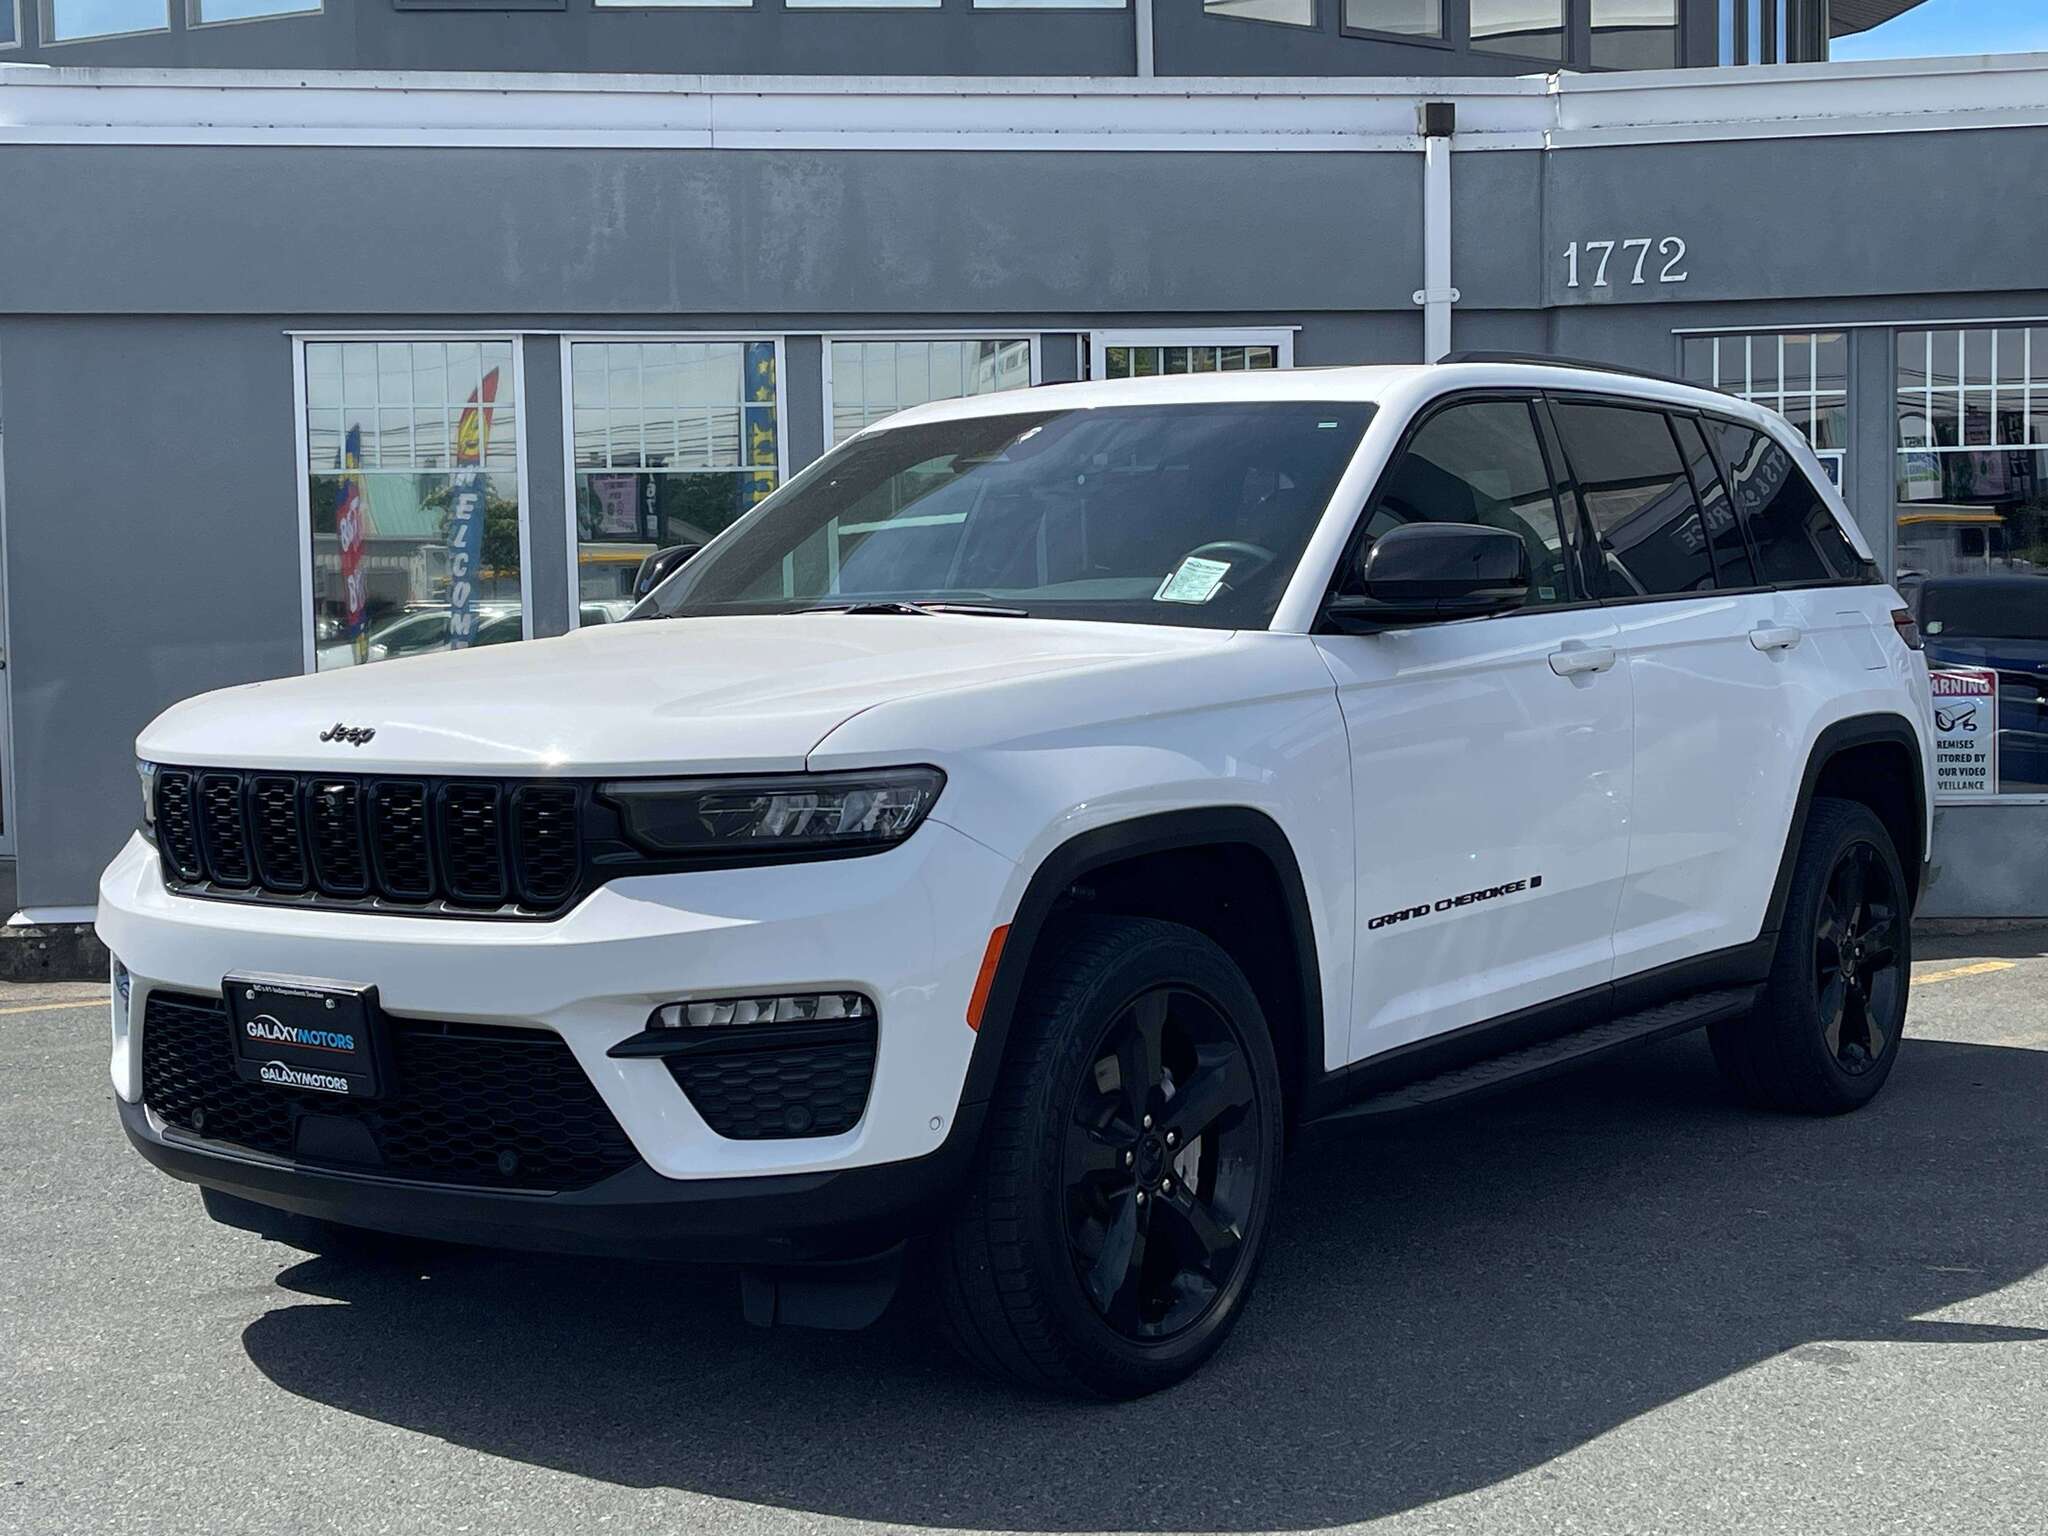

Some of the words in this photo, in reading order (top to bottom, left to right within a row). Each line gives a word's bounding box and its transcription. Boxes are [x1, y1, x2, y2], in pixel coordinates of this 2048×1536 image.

[1563, 236, 1689, 287] 1772
[451, 464, 478, 648] WELCOM
[320, 723, 376, 747] Jeep
[1938, 768, 1957, 776] OUR
[1959, 768, 1986, 776] VIDEO
[1974, 754, 1986, 762] BY
[1368, 904, 1430, 930] GRAND
[1435, 880, 1527, 912] CHEROKEE
